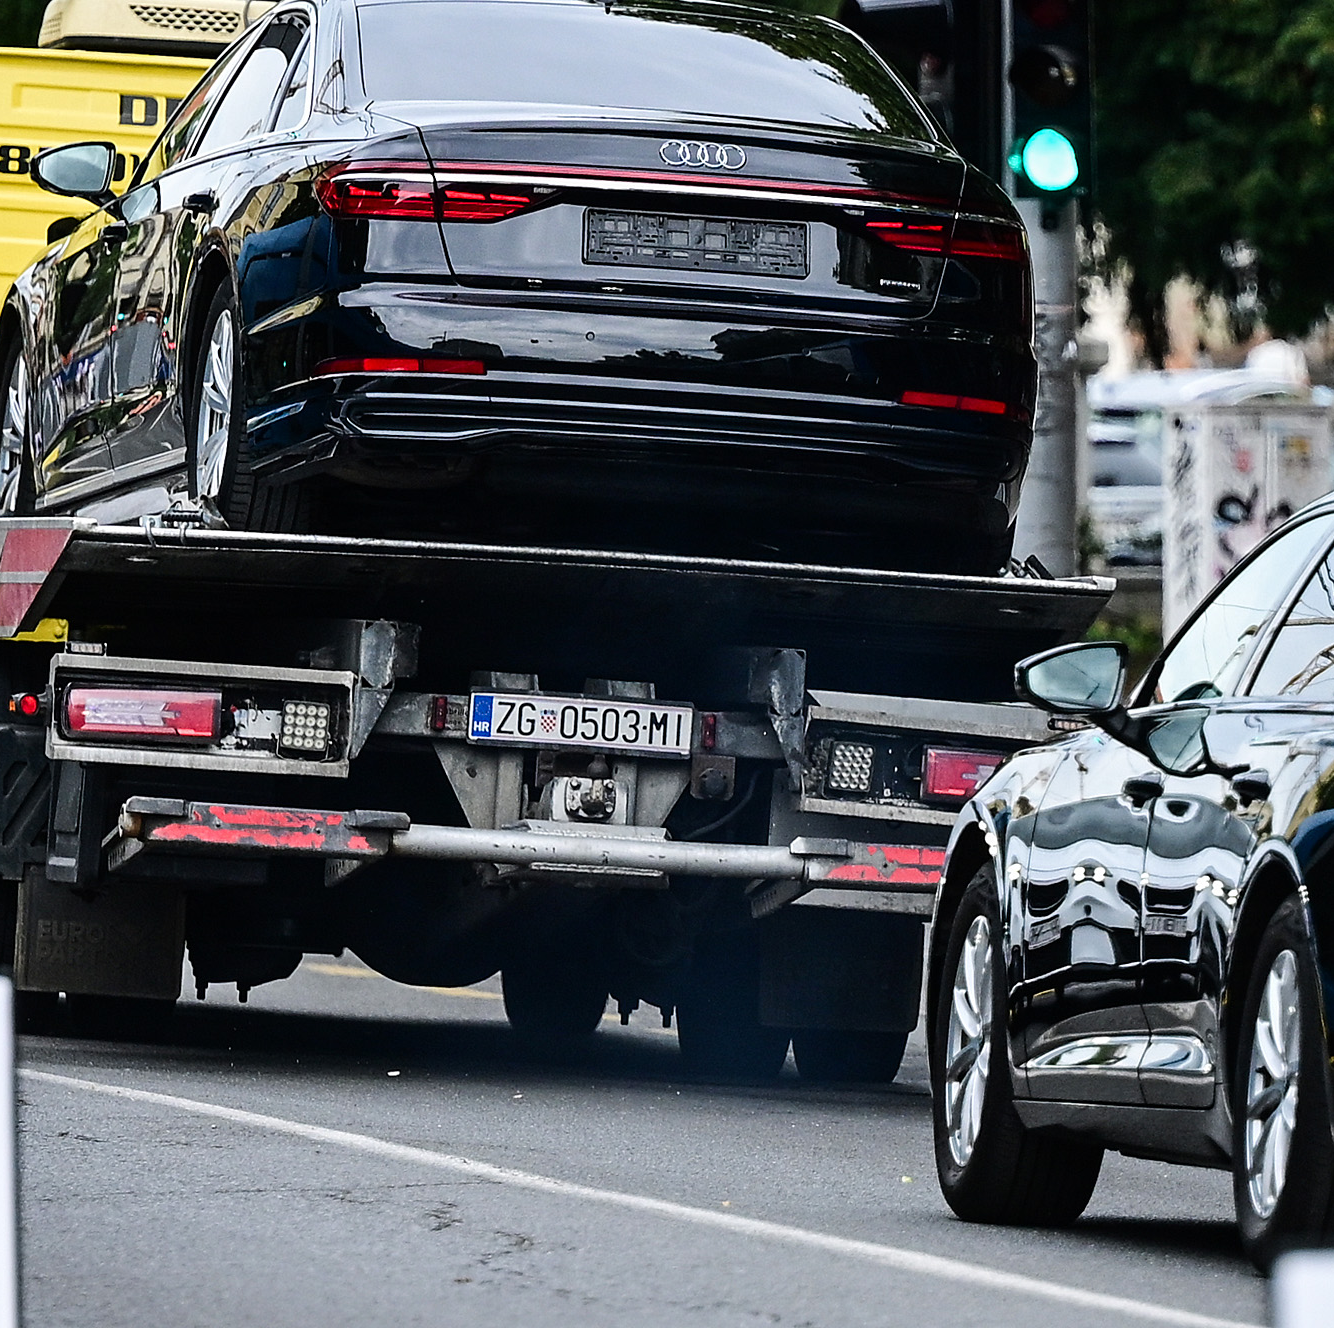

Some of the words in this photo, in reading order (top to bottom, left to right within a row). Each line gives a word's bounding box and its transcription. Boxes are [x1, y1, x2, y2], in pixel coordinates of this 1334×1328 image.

[473, 720, 490, 733] HR
[495, 701, 537, 737] ZG
[559, 705, 683, 747] 0503-MI
